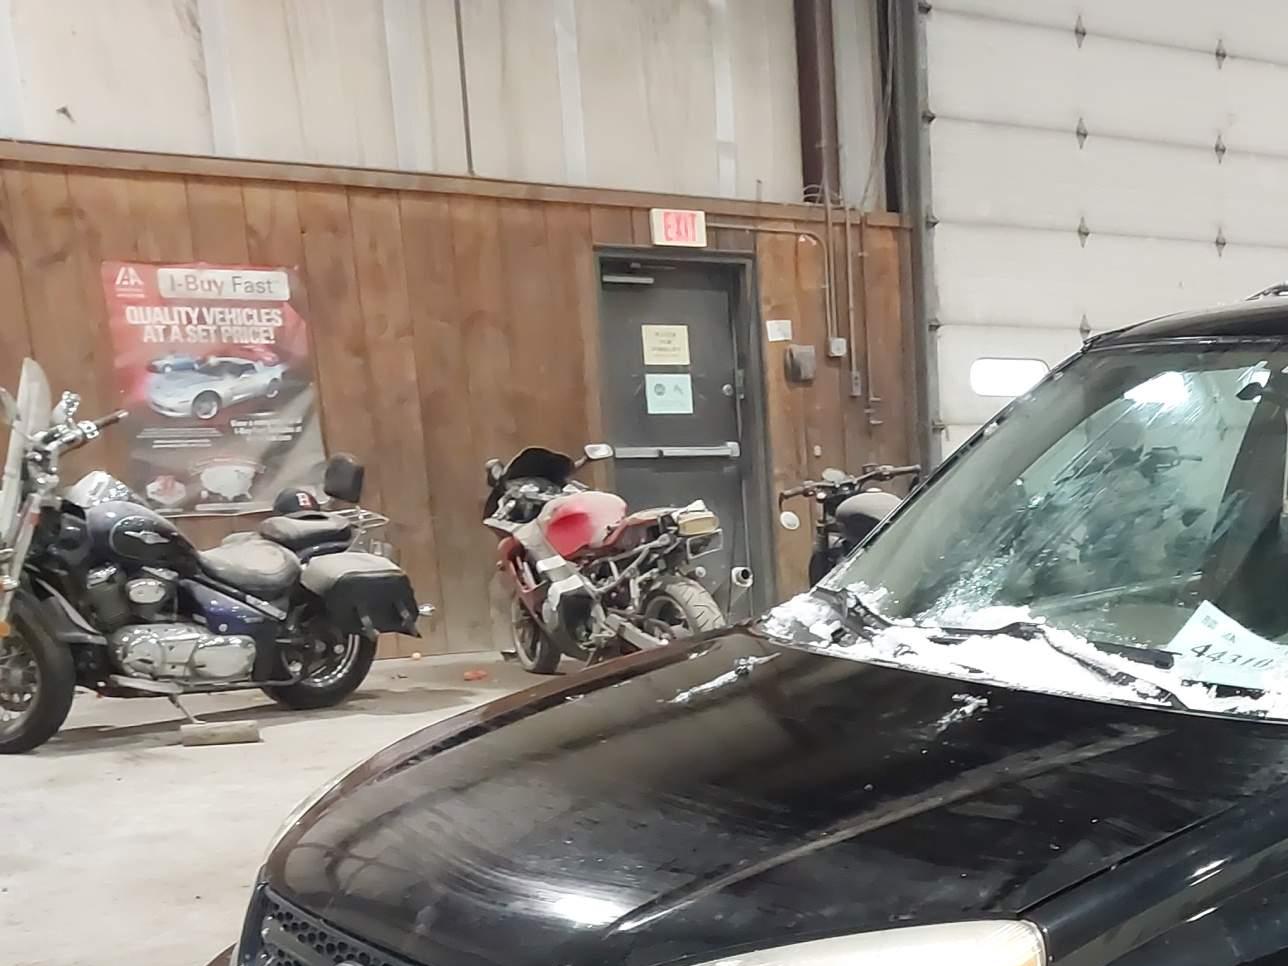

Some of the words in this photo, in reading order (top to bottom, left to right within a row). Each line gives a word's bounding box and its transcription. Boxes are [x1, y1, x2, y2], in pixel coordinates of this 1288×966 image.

[664, 211, 697, 242] EXIT
[169, 274, 224, 296] I-Buy
[231, 276, 273, 294] Fast
[125, 306, 200, 325] QUALITY
[201, 307, 283, 327] VEHICLES
[143, 325, 169, 343] AT
[170, 326, 184, 343] A
[185, 326, 217, 344] SET
[221, 326, 276, 345] PRICE!
